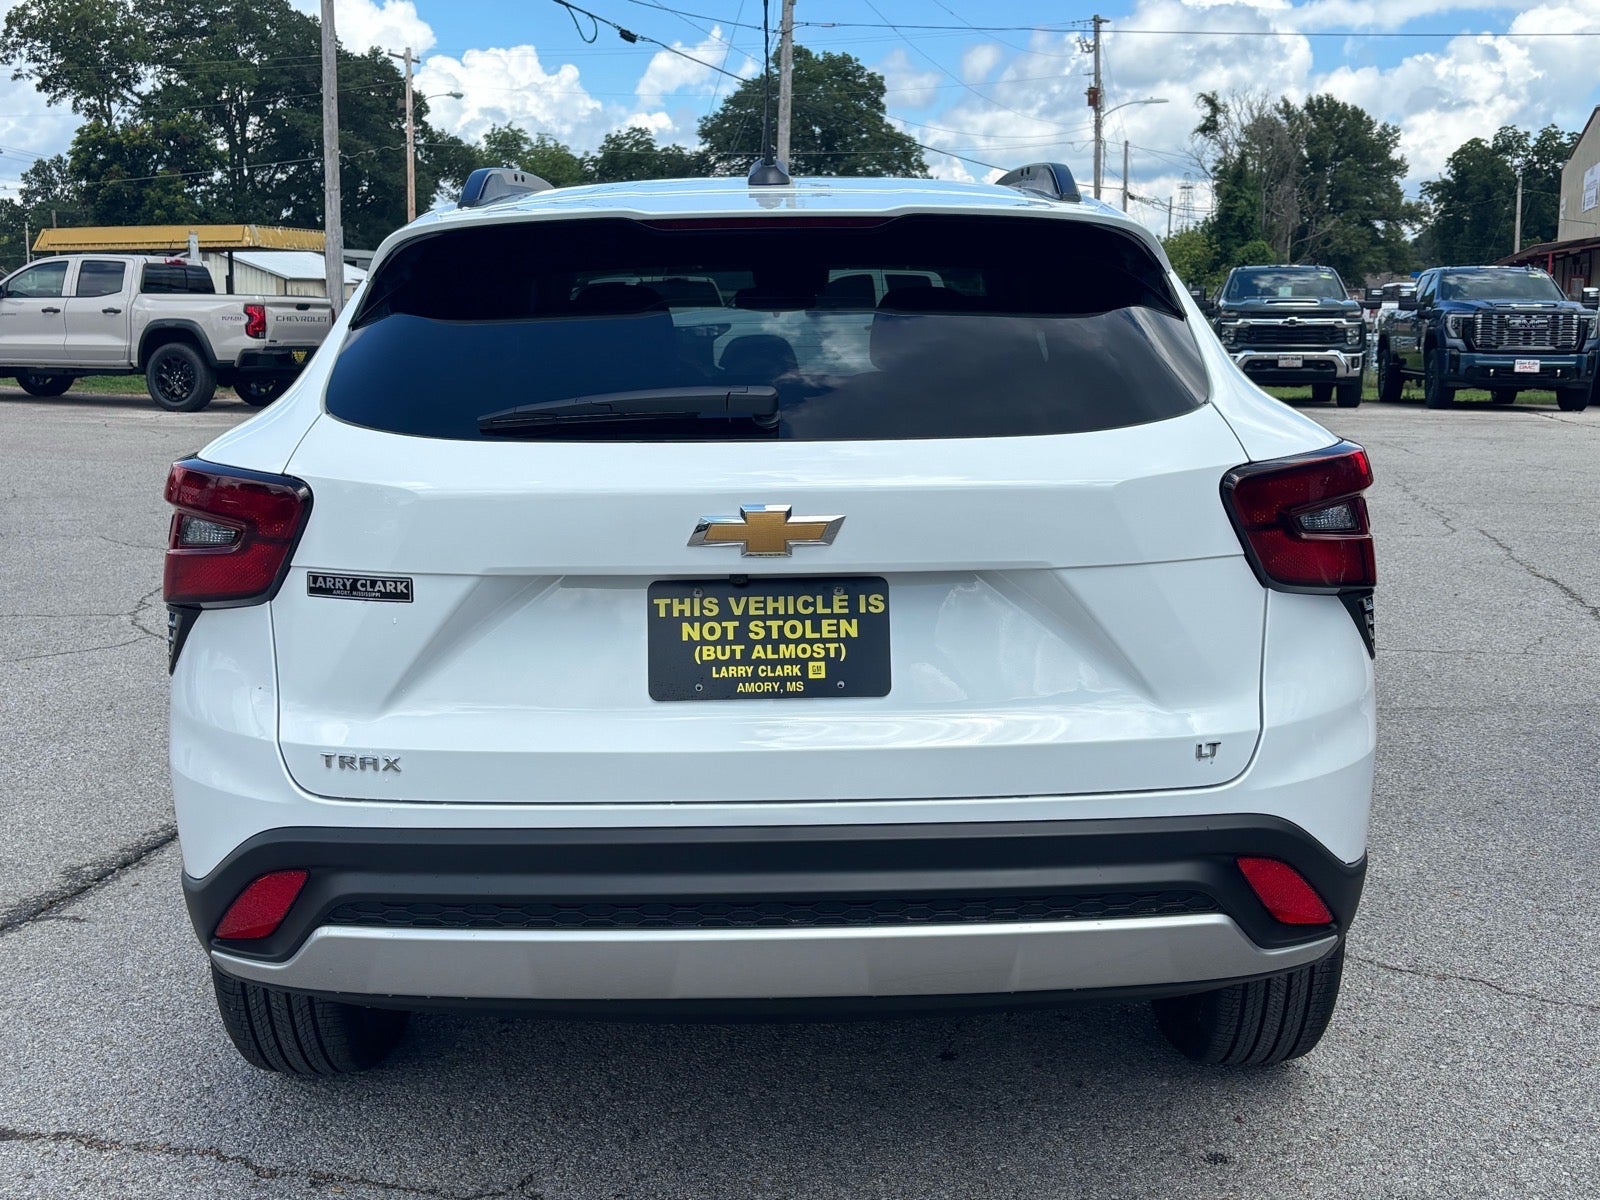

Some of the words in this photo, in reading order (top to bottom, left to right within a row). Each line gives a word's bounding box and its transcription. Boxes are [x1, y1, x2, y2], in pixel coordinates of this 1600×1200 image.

[276, 315, 328, 323] CHEVROLET
[1508, 319, 1549, 328] GMC
[309, 576, 354, 590] LARRY
[356, 580, 408, 593] CLARK
[332, 589, 352, 597] AMORY,
[653, 597, 719, 617] THIS
[728, 594, 849, 616] VEHICLE
[858, 593, 885, 614] IS
[681, 621, 740, 641] NOT
[748, 618, 859, 640] STOLEN
[694, 645, 745, 664] (BUT
[751, 642, 847, 661] ALMOST)
[712, 665, 753, 678] LARRY
[758, 665, 802, 677] CLARK
[736, 682, 784, 693] AMORY,
[786, 681, 804, 692] MS
[1195, 741, 1222, 759] LT
[319, 752, 402, 773] TRAX
